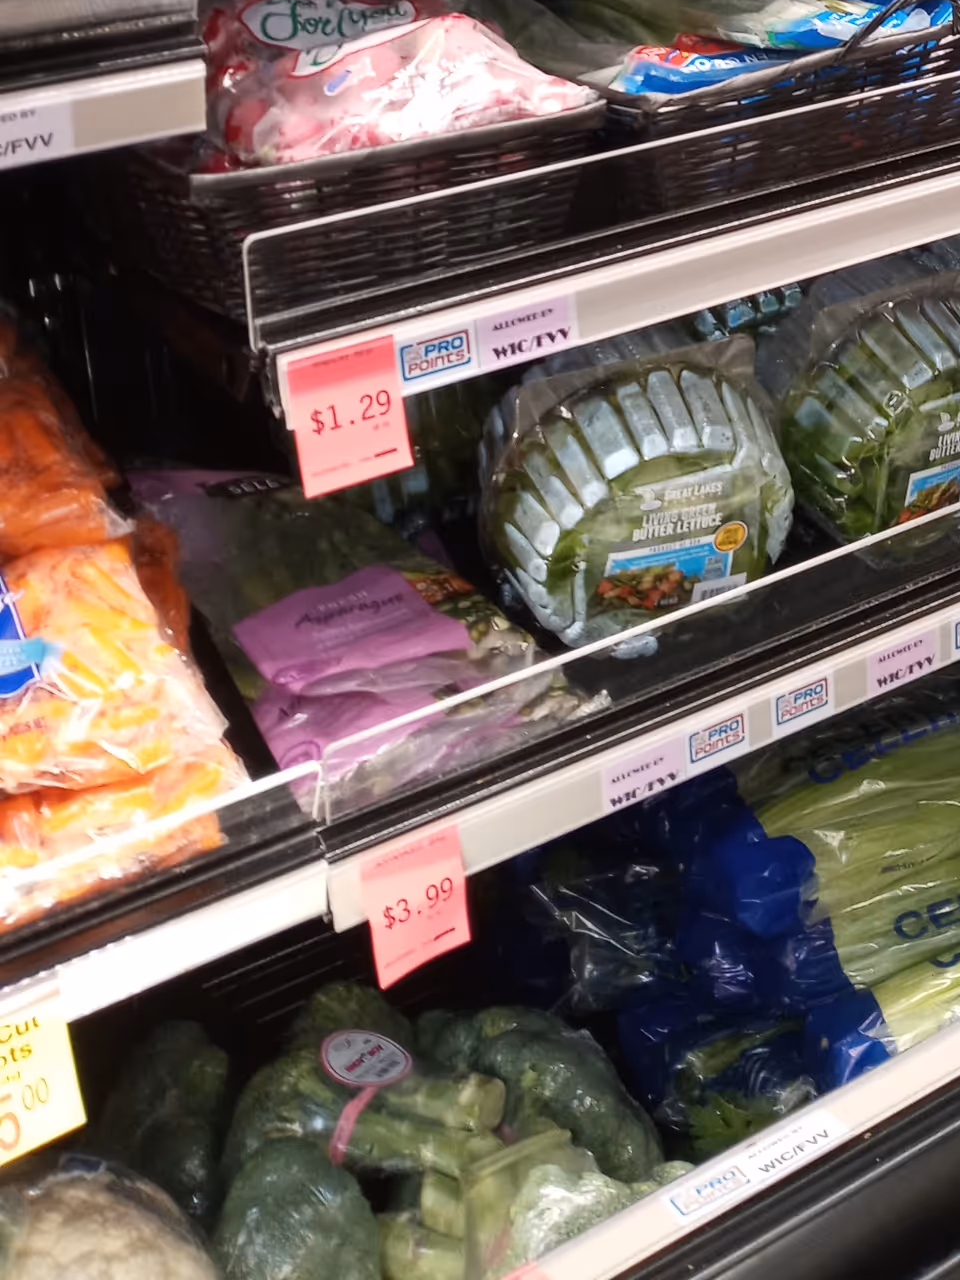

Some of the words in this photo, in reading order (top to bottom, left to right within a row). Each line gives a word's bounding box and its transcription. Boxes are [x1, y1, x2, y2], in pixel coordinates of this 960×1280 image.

[491, 313, 533, 331] ALLOWED
[535, 308, 554, 320] BY
[423, 335, 464, 359] PRO
[492, 326, 571, 361] WIC/FVV
[407, 350, 466, 376] POINTS
[310, 388, 392, 436] $1.29
[664, 487, 693, 501] GREAT
[695, 482, 723, 496] LAKES
[632, 522, 674, 543] BUTTER
[676, 513, 723, 532] LETTUCE
[642, 510, 679, 527] LIVING
[680, 503, 717, 518] GREEN
[295, 592, 405, 630] Asparagus
[875, 653, 937, 689] WIC/FVV
[792, 682, 825, 704] PRO
[780, 694, 825, 725] POINTS
[695, 730, 743, 758] POINTS
[706, 719, 741, 742] PRO
[609, 769, 679, 808] WIC/FVV
[383, 876, 454, 931] $3.99
[758, 1128, 830, 1174] WIC/FVV
[695, 1170, 737, 1195] PRO
